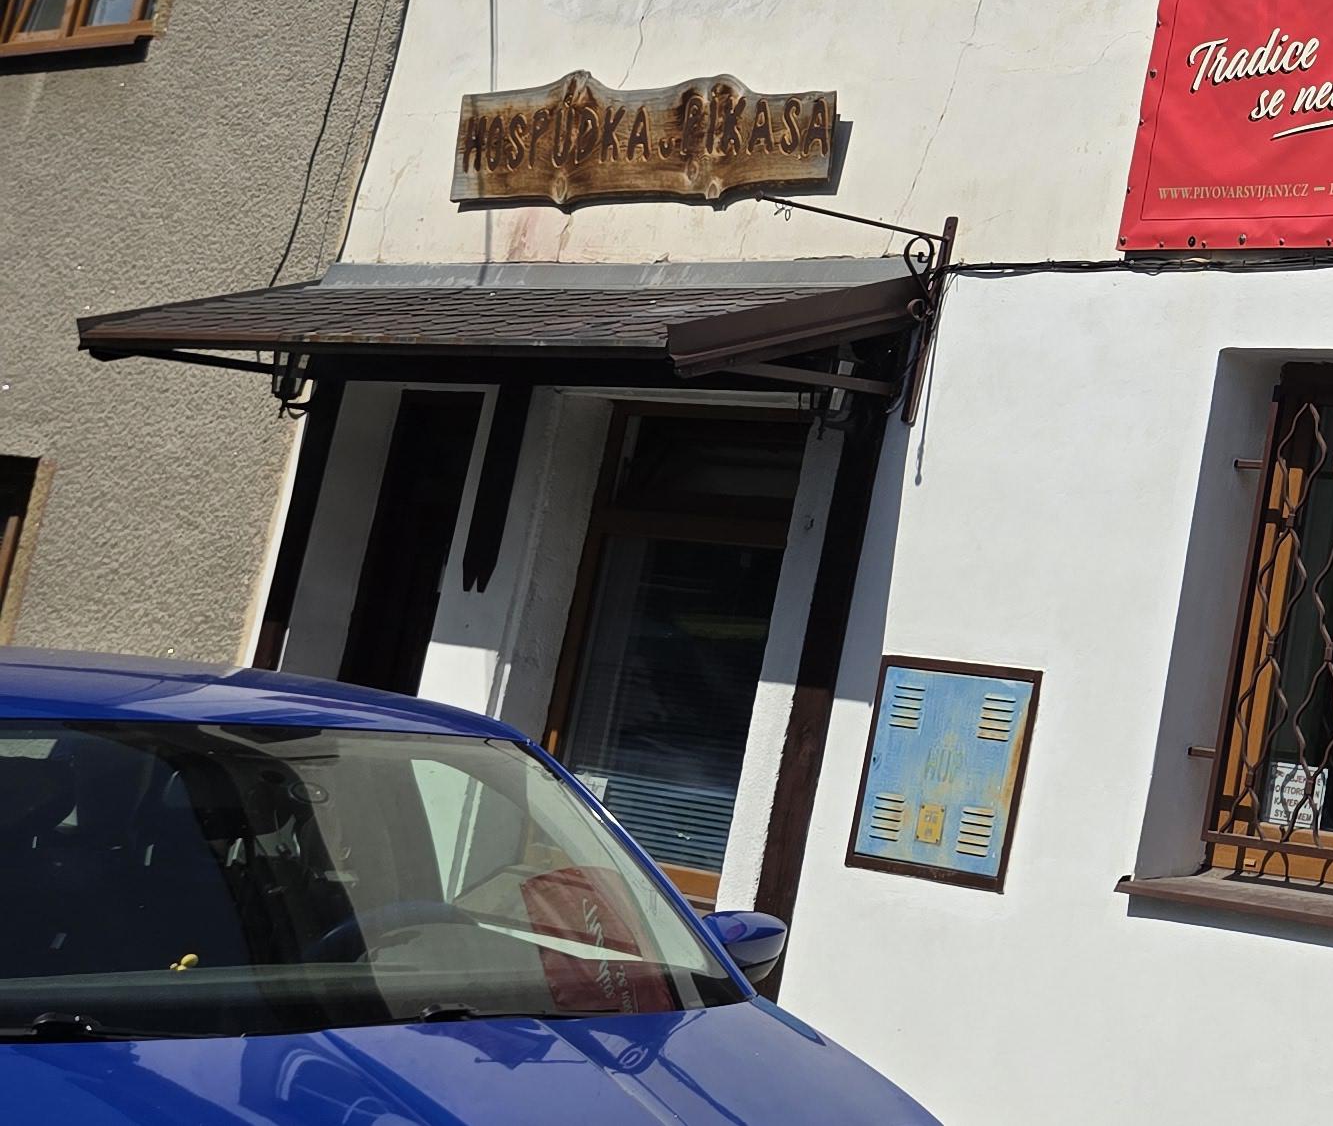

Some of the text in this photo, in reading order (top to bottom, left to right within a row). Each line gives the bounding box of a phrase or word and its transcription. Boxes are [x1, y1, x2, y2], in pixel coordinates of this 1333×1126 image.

[1190, 28, 1320, 92] Tradice
[1251, 87, 1286, 120] se
[464, 94, 651, 174] HOSPŮDKA
[1158, 183, 1309, 201] WWW.PIVOVARSVIJANY.CZ
